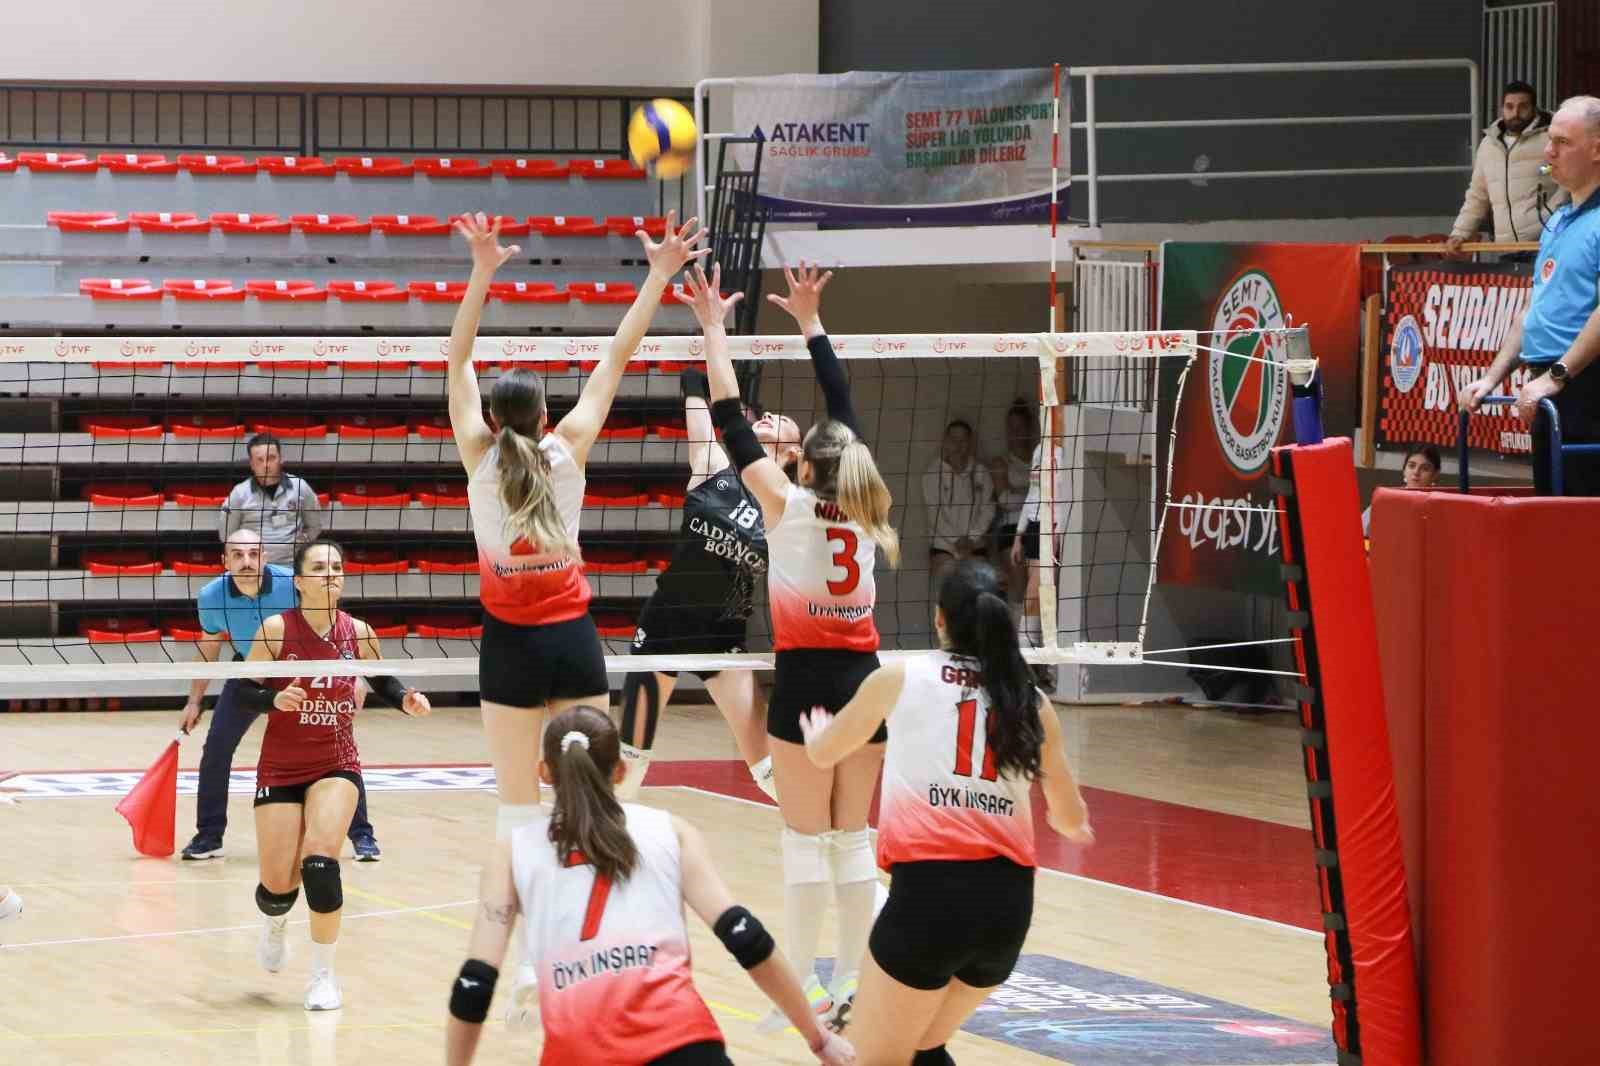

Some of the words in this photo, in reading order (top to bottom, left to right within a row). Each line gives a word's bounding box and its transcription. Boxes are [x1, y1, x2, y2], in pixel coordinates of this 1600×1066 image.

[906, 111, 941, 128] SEMT
[945, 110, 962, 126] 77
[771, 123, 870, 142] ATAKENT
[975, 125, 1032, 145] YOLUNDA
[1223, 280, 1262, 323] SEMT
[5, 345, 25, 353] TVF
[71, 345, 91, 353] TVF
[136, 345, 157, 353] TVF
[201, 345, 221, 353] TVF
[264, 345, 285, 353] TVF
[328, 345, 349, 353] TVF
[392, 345, 412, 353] TVF
[518, 344, 537, 353] TVF
[580, 344, 600, 353] TVF
[642, 344, 661, 352] TVF
[765, 344, 784, 352] TVF
[948, 342, 968, 350] TVF
[1009, 341, 1028, 350] TVF
[728, 499, 760, 529] 18
[826, 527, 860, 596] 3
[299, 712, 338, 726] BOYA
[929, 784, 961, 807] ÖYK
[965, 786, 1014, 816] İNŞAAT
[562, 850, 616, 942] 7
[553, 961, 589, 990] ÖYK
